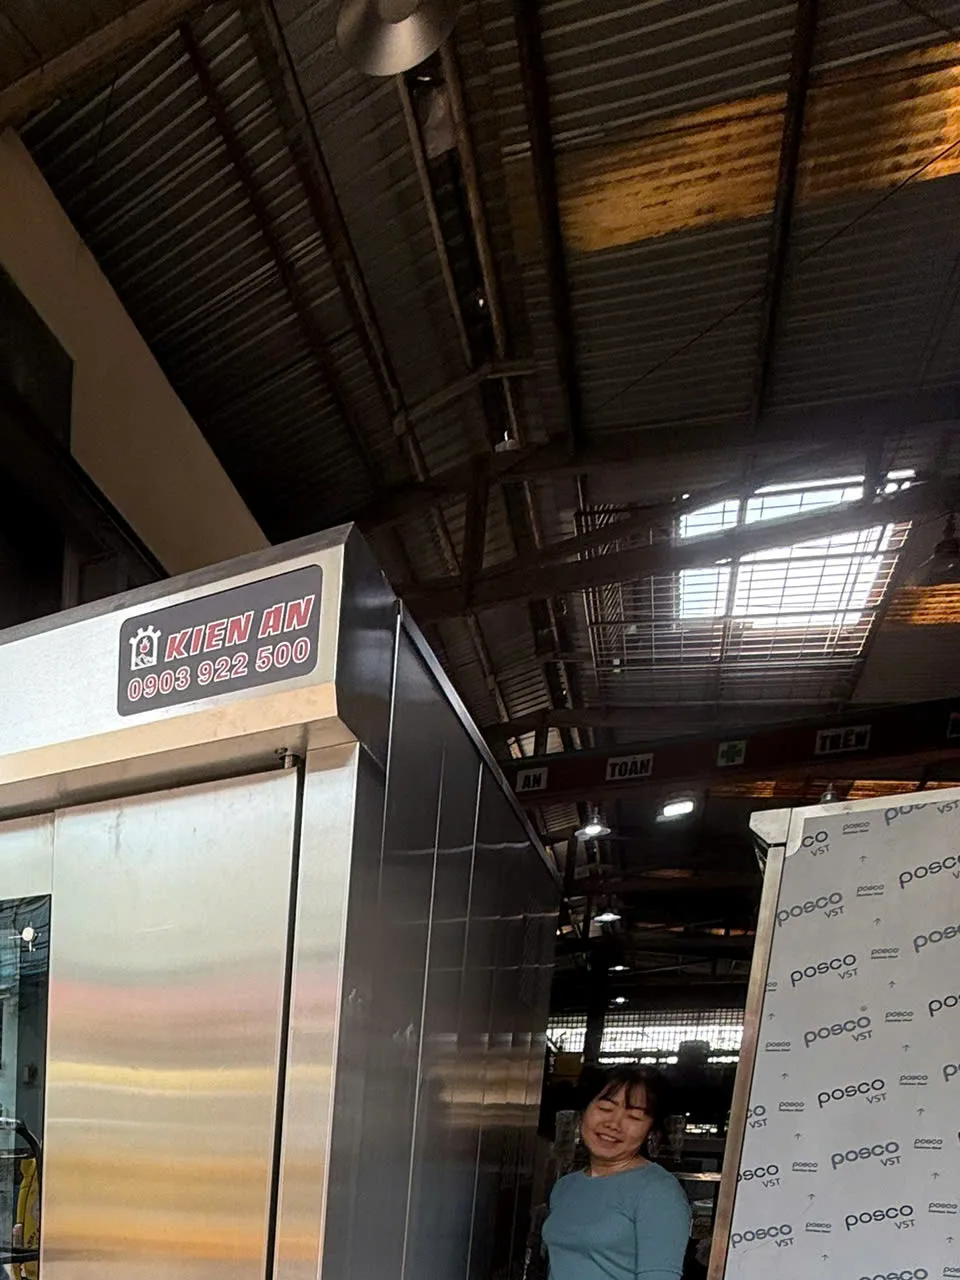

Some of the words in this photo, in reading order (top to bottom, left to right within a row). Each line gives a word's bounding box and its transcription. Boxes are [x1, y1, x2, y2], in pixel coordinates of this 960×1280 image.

[164, 610, 254, 662] KIEN
[258, 594, 315, 638] AN
[127, 665, 190, 701] 0903
[197, 652, 248, 685] 922
[255, 637, 311, 672] 500
[811, 845, 830, 857] VST
[777, 892, 842, 927] posco
[825, 905, 844, 918] VST
[790, 954, 856, 987] posco
[838, 968, 858, 980] VST
[804, 1016, 871, 1048] posco
[852, 1030, 873, 1042] VST
[817, 1079, 885, 1108] posco
[866, 1093, 887, 1105] VST
[749, 1118, 768, 1129] VST
[831, 1142, 900, 1170] posco
[880, 1156, 901, 1167] VST
[762, 1178, 781, 1188] VST
[845, 1205, 913, 1231] posco
[895, 1219, 916, 1230] VST
[731, 1224, 792, 1248] posco
[775, 1238, 794, 1248] VST
